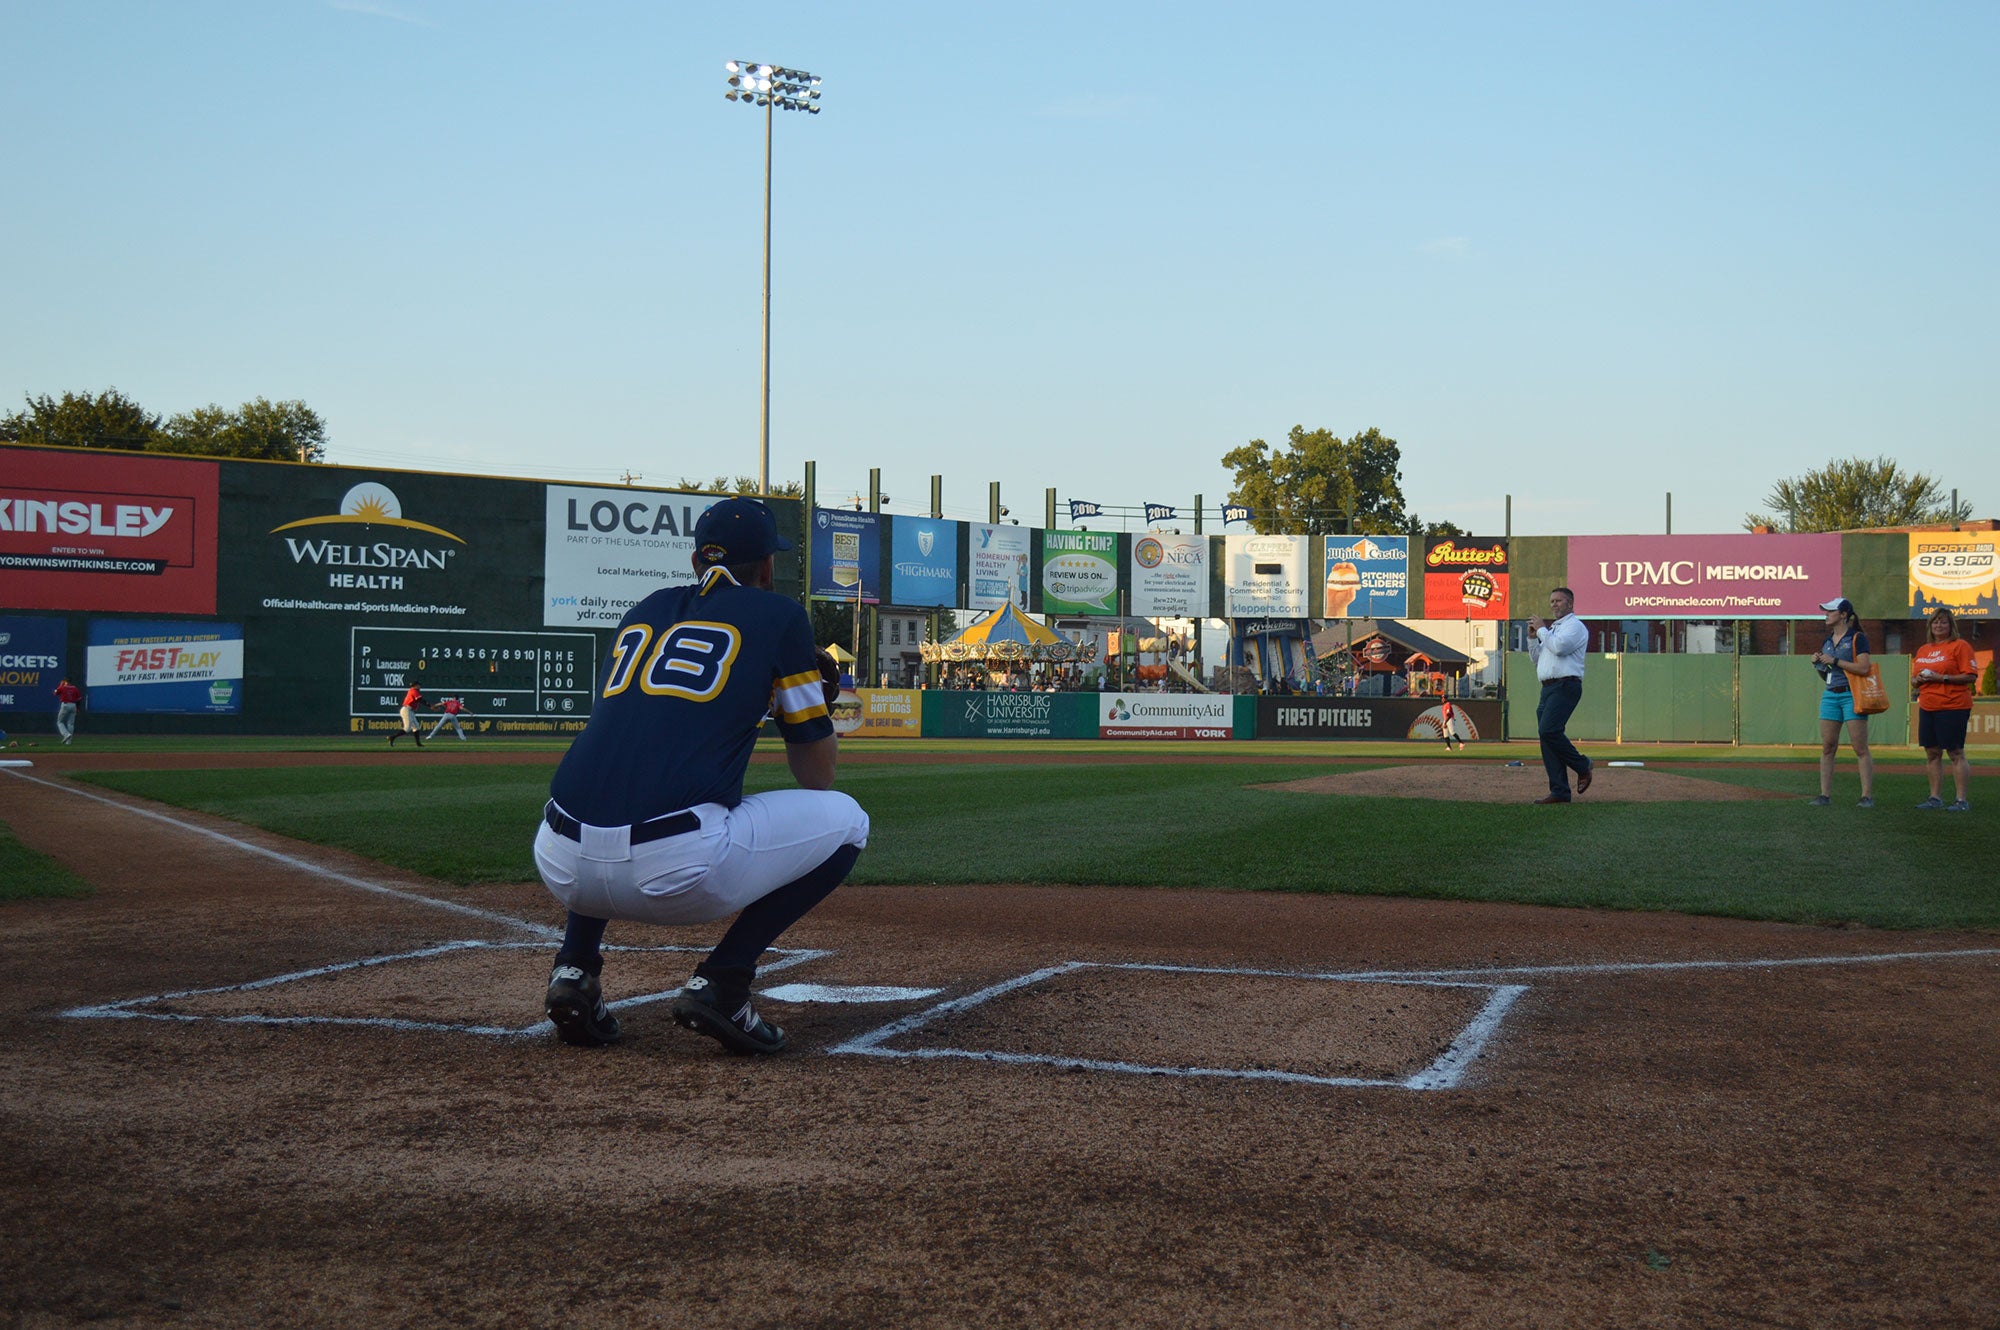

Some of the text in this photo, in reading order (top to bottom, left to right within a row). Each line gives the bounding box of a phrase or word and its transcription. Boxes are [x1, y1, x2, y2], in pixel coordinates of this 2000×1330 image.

[1072, 503, 1096, 517] 2010
[1148, 507, 1170, 520] 2011
[1225, 507, 1248, 522] 2017
[0, 499, 174, 537] KINSLEY
[567, 535, 697, 550] PART OF THE USA TODAY NETW
[834, 533, 858, 546] BEST
[1046, 533, 1113, 551] HAVING FUN?
[52, 546, 77, 554] ENTER
[1327, 547, 1406, 561] White Castle
[1427, 541, 1505, 565] Rutter's
[1919, 544, 1976, 553] SPORTS
[0, 556, 155, 571] YORKWINSWITHKINSLEY.COM
[976, 553, 1011, 561] HOMERUN
[1167, 552, 1202, 564] NECA
[1967, 556, 1993, 566] FM
[976, 561, 1007, 569] HEALTHY
[597, 566, 698, 580] Local Marketing, Simpli
[900, 565, 953, 579] HIGHMARK
[976, 569, 999, 577] LIVING
[1049, 571, 1077, 580] REVIEW
[1077, 572, 1089, 580] US
[1361, 571, 1406, 580] PITCHING
[1599, 561, 1809, 586] UPMC MEMORIAL
[329, 574, 404, 590] HEALTH
[1066, 583, 1107, 594] tripadvisor
[1361, 580, 1406, 588] SLIDERS
[1463, 584, 1490, 598] VIP
[263, 598, 466, 615] Official Healthcare and Sports Medicine Provider
[552, 596, 639, 609] york daily recor
[1625, 596, 1781, 607] UPMCPinnacle.com/TheFuture
[577, 610, 622, 621] ydr.com
[1232, 604, 1302, 614] kleppers.com
[362, 646, 371, 656] P
[421, 648, 574, 661] 1 2 3 4 5 6 7 8 9 10 R H E
[362, 659, 574, 673] 16 Lancaster 0 0 0 0
[603, 620, 742, 703] 18
[118, 670, 215, 682] PLAY FAST. WIN INSTANTLY.
[360, 673, 574, 688] 20 YORK 0 0 0
[380, 696, 399, 706] BALL
[493, 698, 507, 707] OUT
[871, 694, 911, 703] Baseball &
[987, 694, 1051, 707] HARRISBURG
[870, 704, 912, 714] HOT DOGS
[987, 706, 1050, 718] UNIVERSITY
[1132, 702, 1225, 720] CommunityAid
[1277, 707, 1372, 727] FIRST PITCHES
[987, 727, 1051, 736] www.HarrisburgU.edu
[1106, 729, 1226, 737] CommunityAid.net YORK
